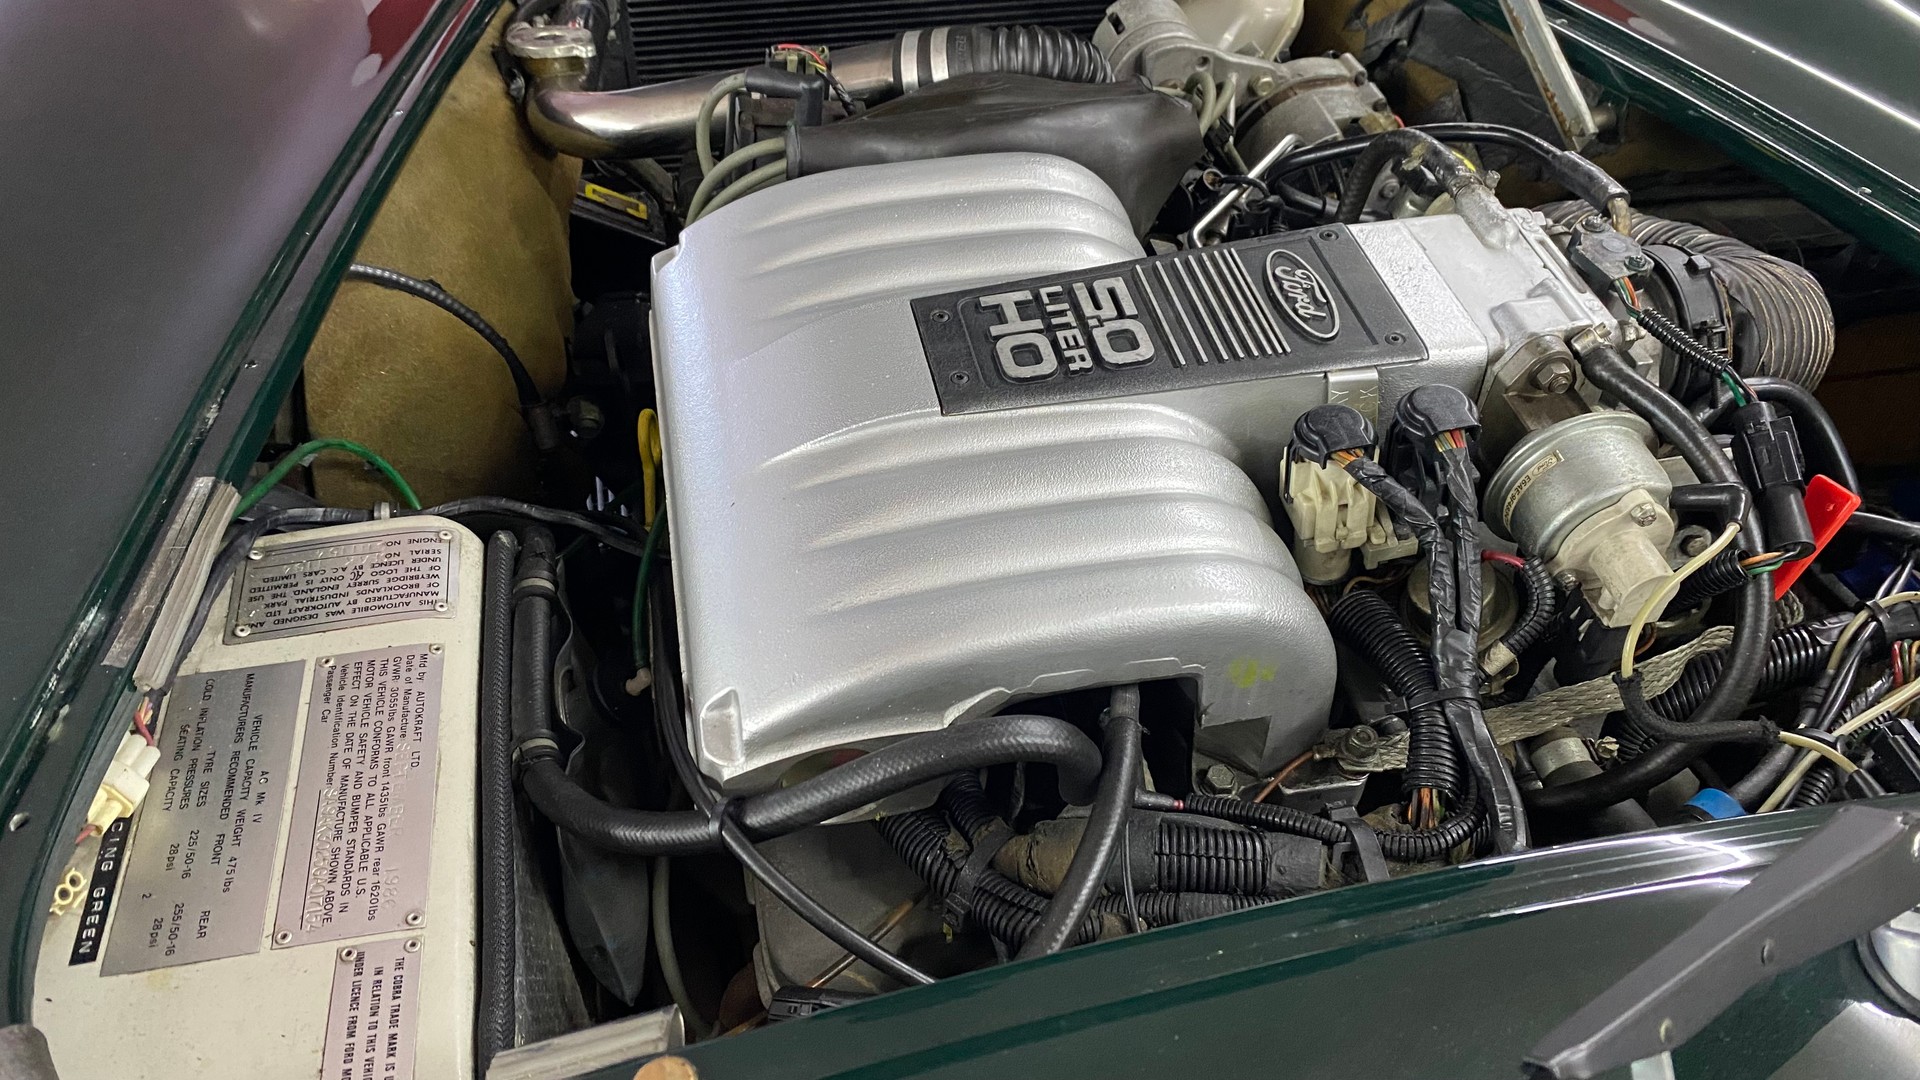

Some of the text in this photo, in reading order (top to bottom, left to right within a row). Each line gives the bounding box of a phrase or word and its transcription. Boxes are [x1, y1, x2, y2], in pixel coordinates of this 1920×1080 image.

[1275, 266, 1326, 318] Ford
[1039, 286, 1093, 371] LITER
[1072, 276, 1155, 364] 5.0
[979, 290, 1058, 378] HO
[349, 571, 364, 581] AC
[370, 560, 404, 568] LICENCE
[249, 582, 298, 593] PERMITTED
[320, 575, 344, 583] ONLY
[346, 579, 379, 588] SURREY
[356, 583, 419, 595] BROOKLANDS
[386, 573, 440, 583] WEYBRIDGE
[264, 601, 287, 609] PARK
[288, 601, 341, 614] AUTOKRAFT
[295, 592, 348, 603] INDUSTRIAL
[351, 601, 411, 613] AUTOMOBILE
[365, 591, 439, 603] MANUFACTURED
[273, 614, 318, 625] DESIGNED
[406, 655, 415, 672] Date
[419, 654, 428, 668] Mfd
[202, 679, 215, 701] COLD
[338, 664, 349, 691] Vehicle
[321, 666, 336, 723] Passenger Car
[331, 695, 345, 748] Identification
[413, 691, 425, 742] AUTOKRAFT
[192, 708, 209, 751] INFLATION
[248, 715, 263, 751] VEHICLE
[385, 727, 395, 753] GAWR
[174, 724, 190, 761] SEATING
[382, 758, 392, 777] front
[410, 751, 420, 770] LTD.
[162, 768, 180, 812] CAPACITY
[179, 758, 198, 810] PRESSURES
[240, 759, 255, 800] CAPACITY
[339, 660, 375, 913] MOTOR VEHICLE SAFETY AND BUMPER STANDARDS IN
[355, 659, 389, 898] THIS VEHICLE CONFORMS TO ALL APPLICABLE U.S.
[197, 673, 254, 939] MANUFACTURERS RECOMMENDED FRONT REAR
[253, 771, 269, 823] AC Mk IV
[322, 661, 362, 926] EFFECT ON THE DATE OF MANUFACTURE SHOWN ABOVE.
[231, 809, 246, 846] WEIGHT
[375, 823, 386, 852] GAWR
[165, 751, 216, 956] TYRE SIZES 225/50-16 255/50-16
[372, 858, 381, 876] rear
[78, 887, 106, 953] GREEN
[353, 951, 365, 977] UNDER
[374, 967, 384, 976] IN
[394, 957, 405, 971] THE
[349, 980, 362, 1011] LICENCE
[369, 979, 382, 1017] RELATION
[392, 975, 403, 1000] COBRA
[346, 1016, 357, 1039] FROM
[368, 1020, 378, 1030] TO
[389, 1004, 400, 1029] TRADE
[344, 1043, 355, 1064] FORD
[365, 1034, 376, 1053] THIS
[386, 1033, 398, 1058] MARK
[385, 1063, 395, 1071] IS
